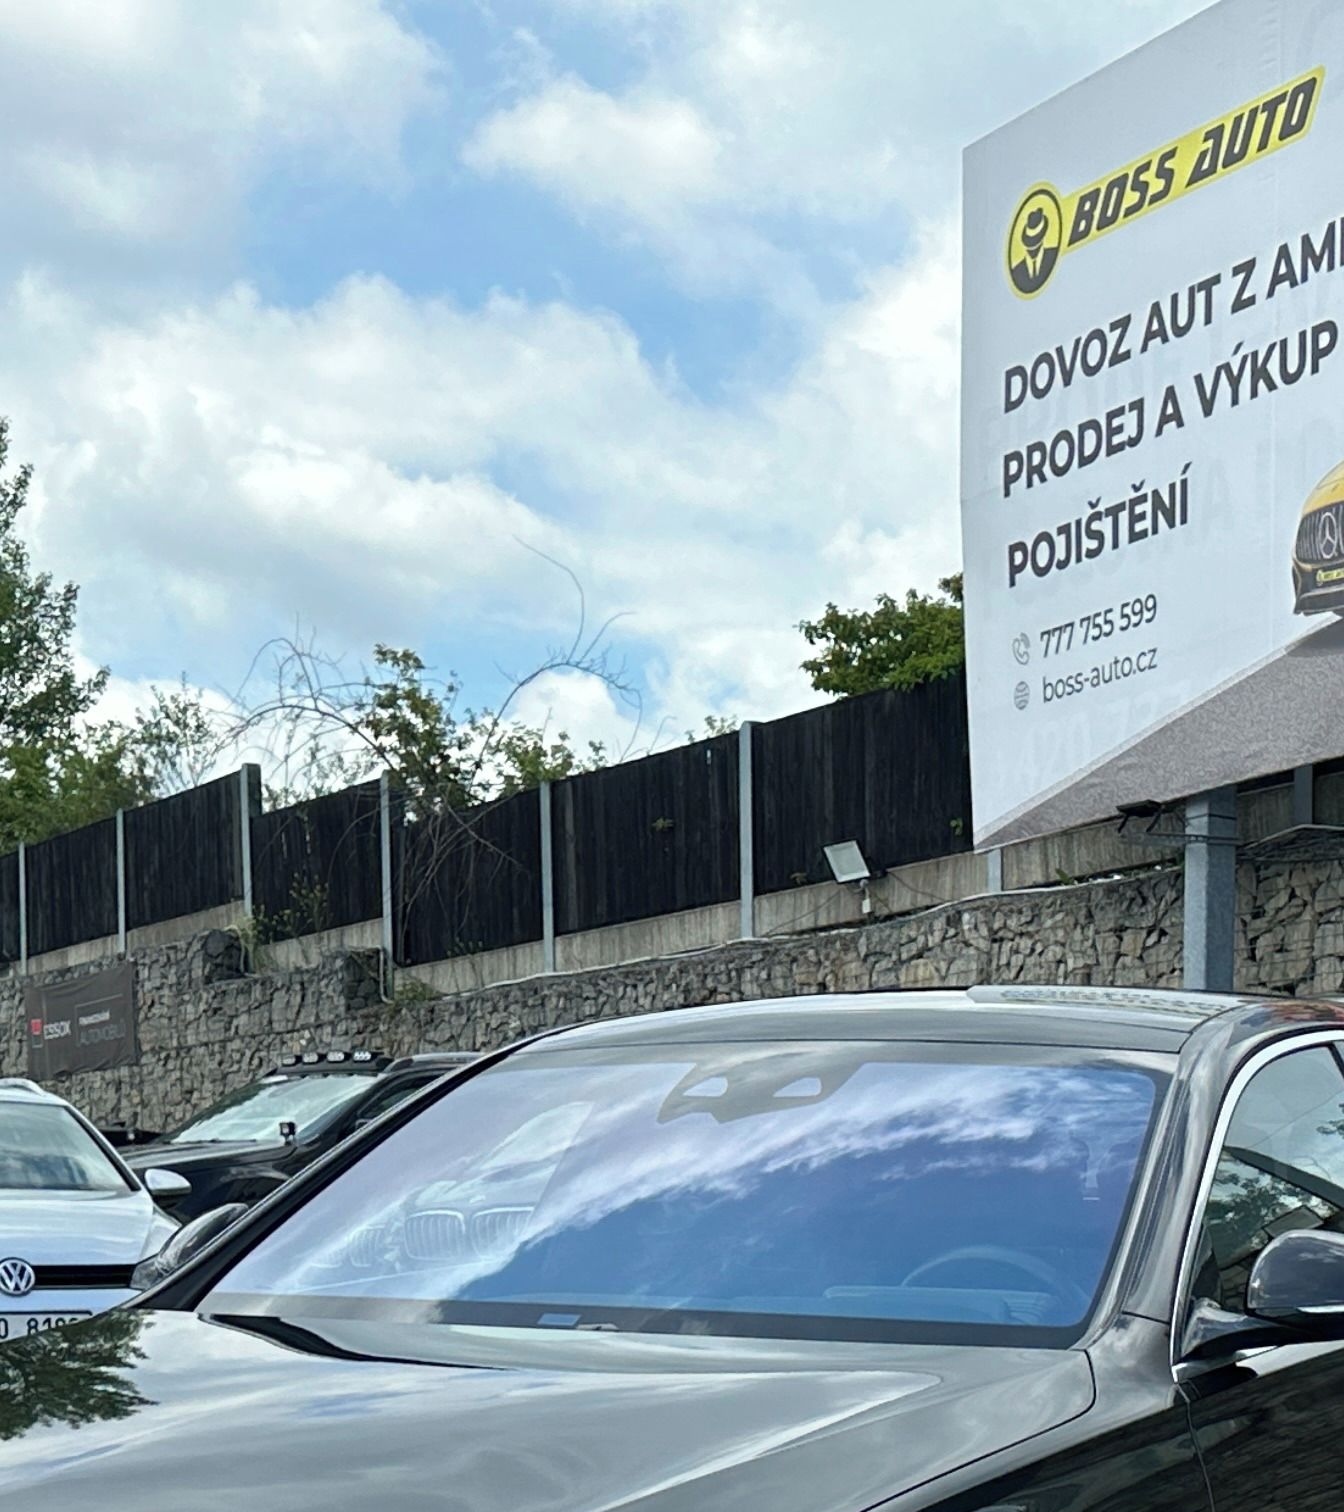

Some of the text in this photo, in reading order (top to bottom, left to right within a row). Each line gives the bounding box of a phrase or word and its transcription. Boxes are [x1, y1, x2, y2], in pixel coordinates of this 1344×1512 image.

[1067, 76, 1318, 248] BOSS AUTO
[1004, 314, 1132, 414] DOVOZ
[1140, 273, 1222, 354] AUT
[1230, 256, 1257, 315] Z
[1004, 319, 1339, 499] PRODEJ A VÝKUP
[1008, 461, 1192, 588] POJIŠTĚNÍ
[1040, 594, 1157, 658] 777 755 599
[1043, 647, 1158, 704] boss-auto.cz
